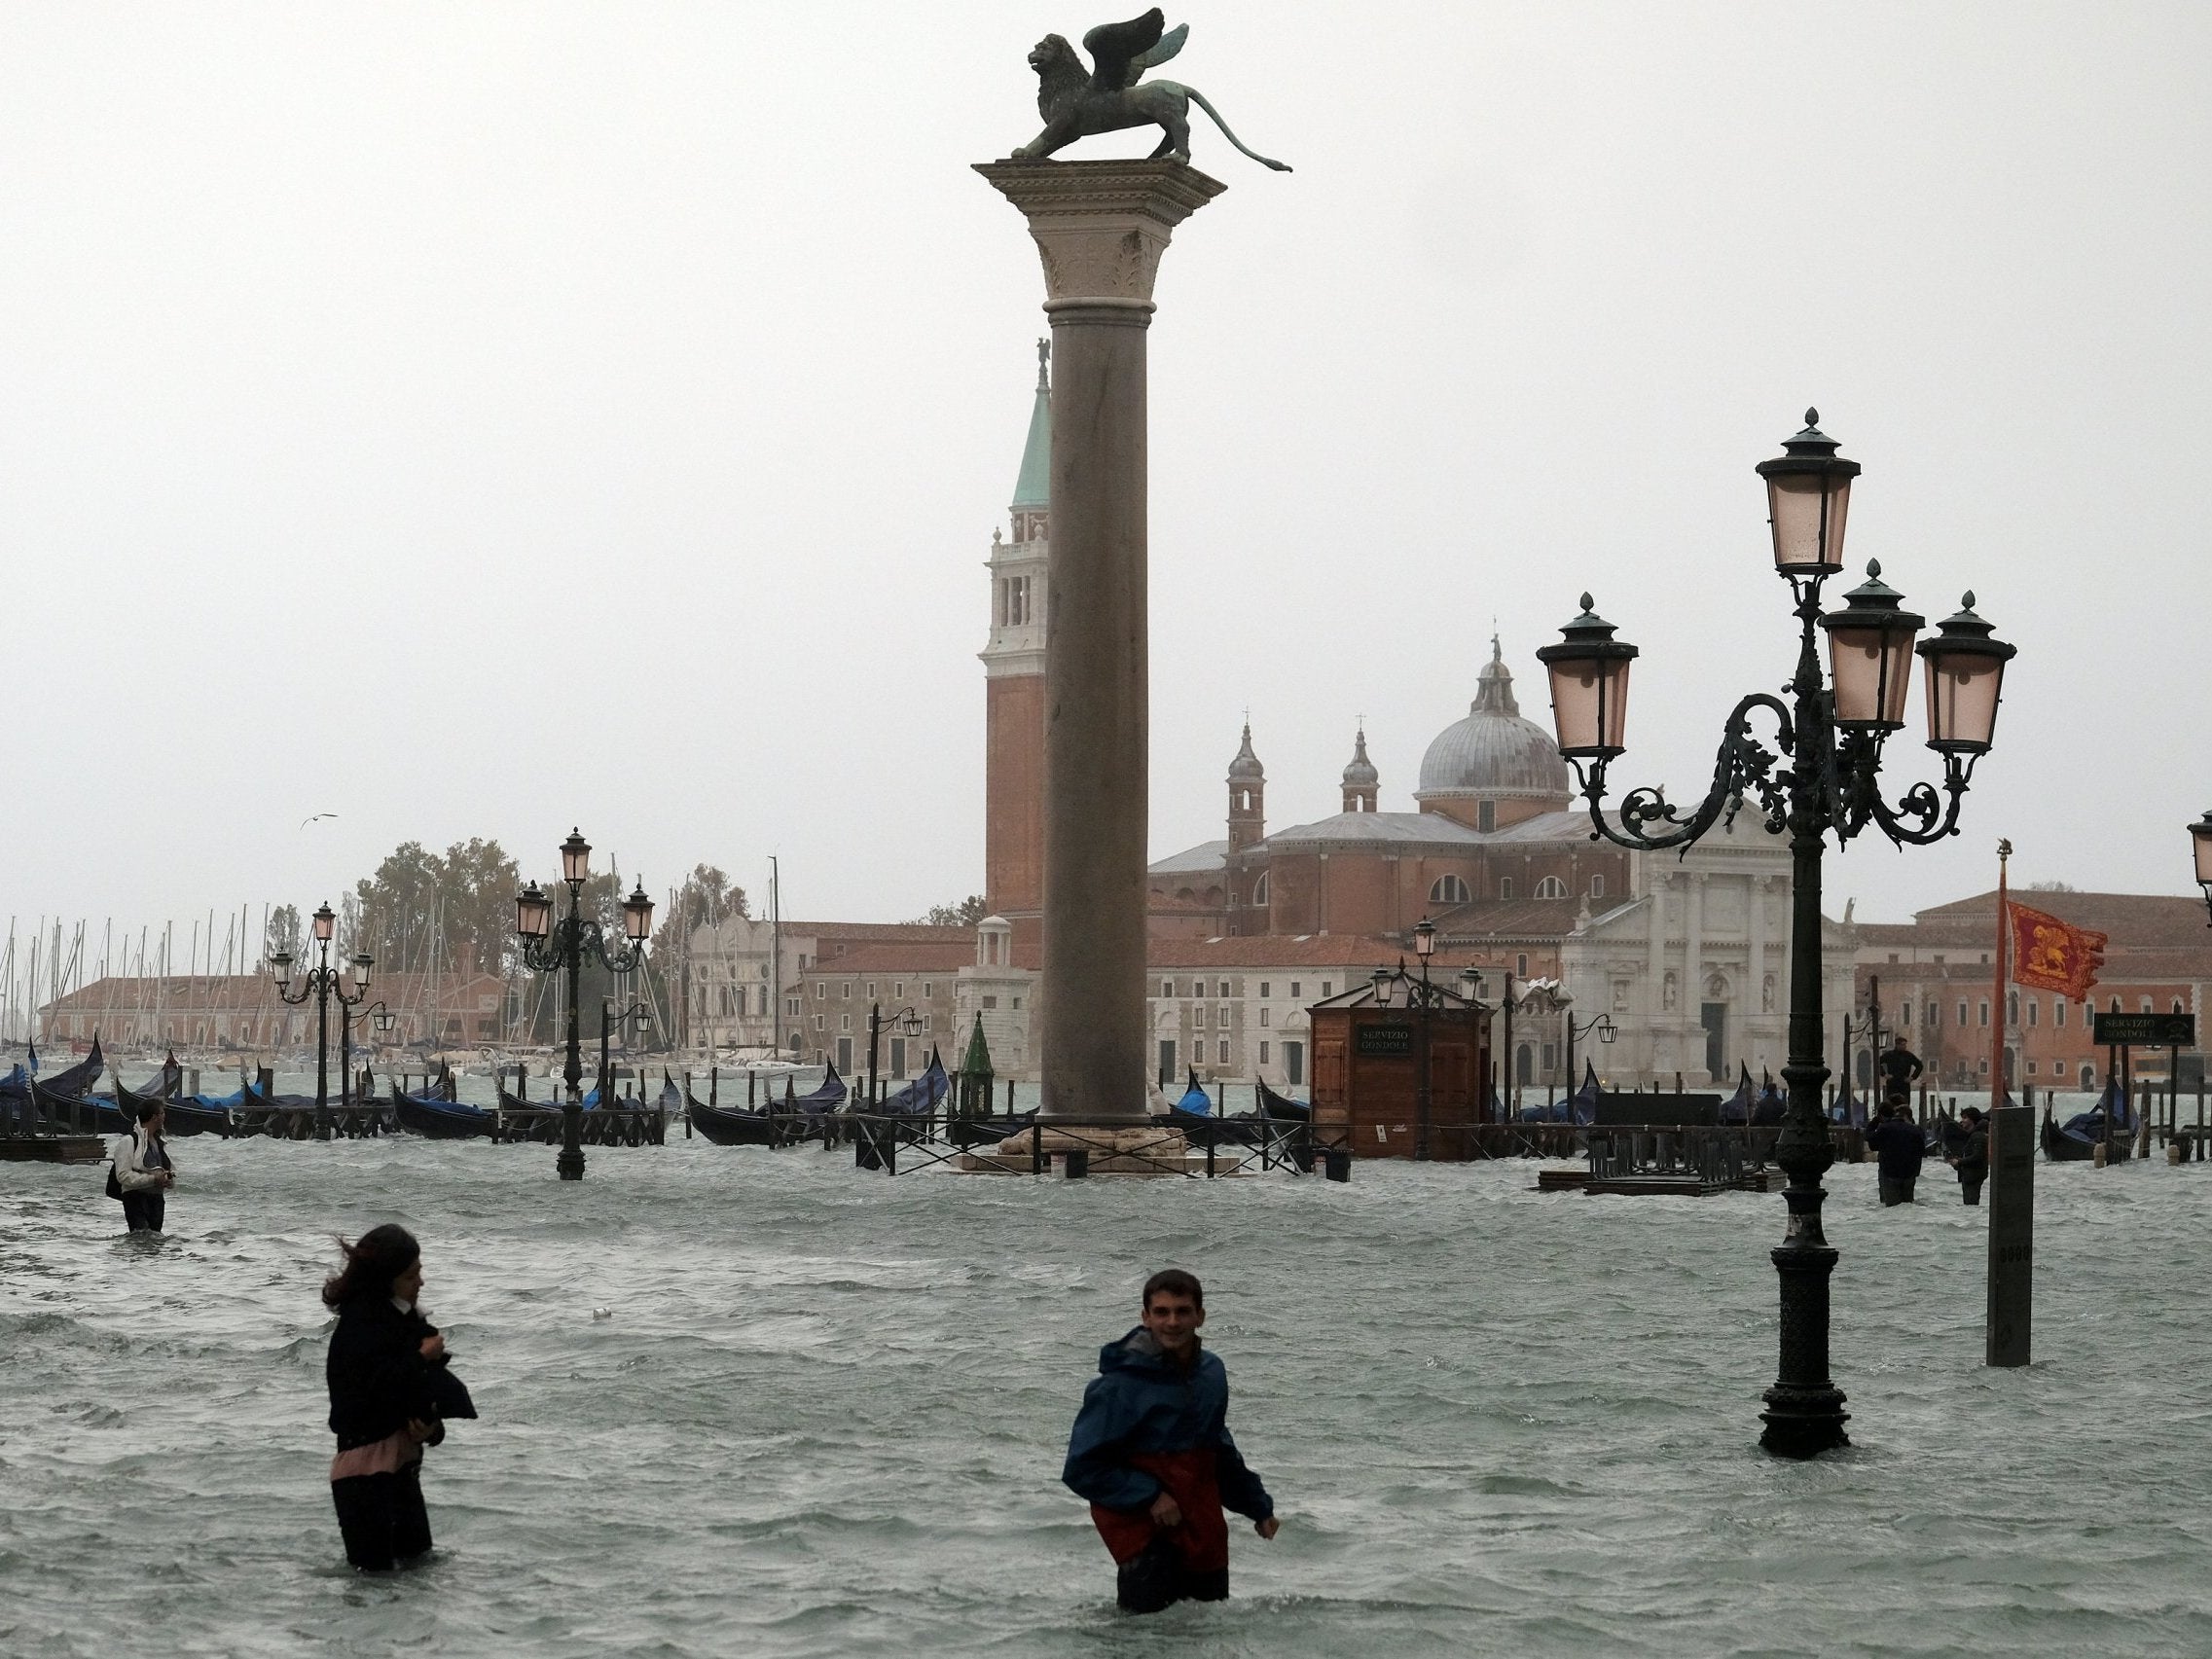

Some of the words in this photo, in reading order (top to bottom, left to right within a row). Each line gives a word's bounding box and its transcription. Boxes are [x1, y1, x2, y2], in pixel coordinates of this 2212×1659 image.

[2105, 1019, 2156, 1028] SERVIZIO
[1362, 1030, 1408, 1039] SERVIZIO
[1361, 1041, 1408, 1050] GONDOLE
